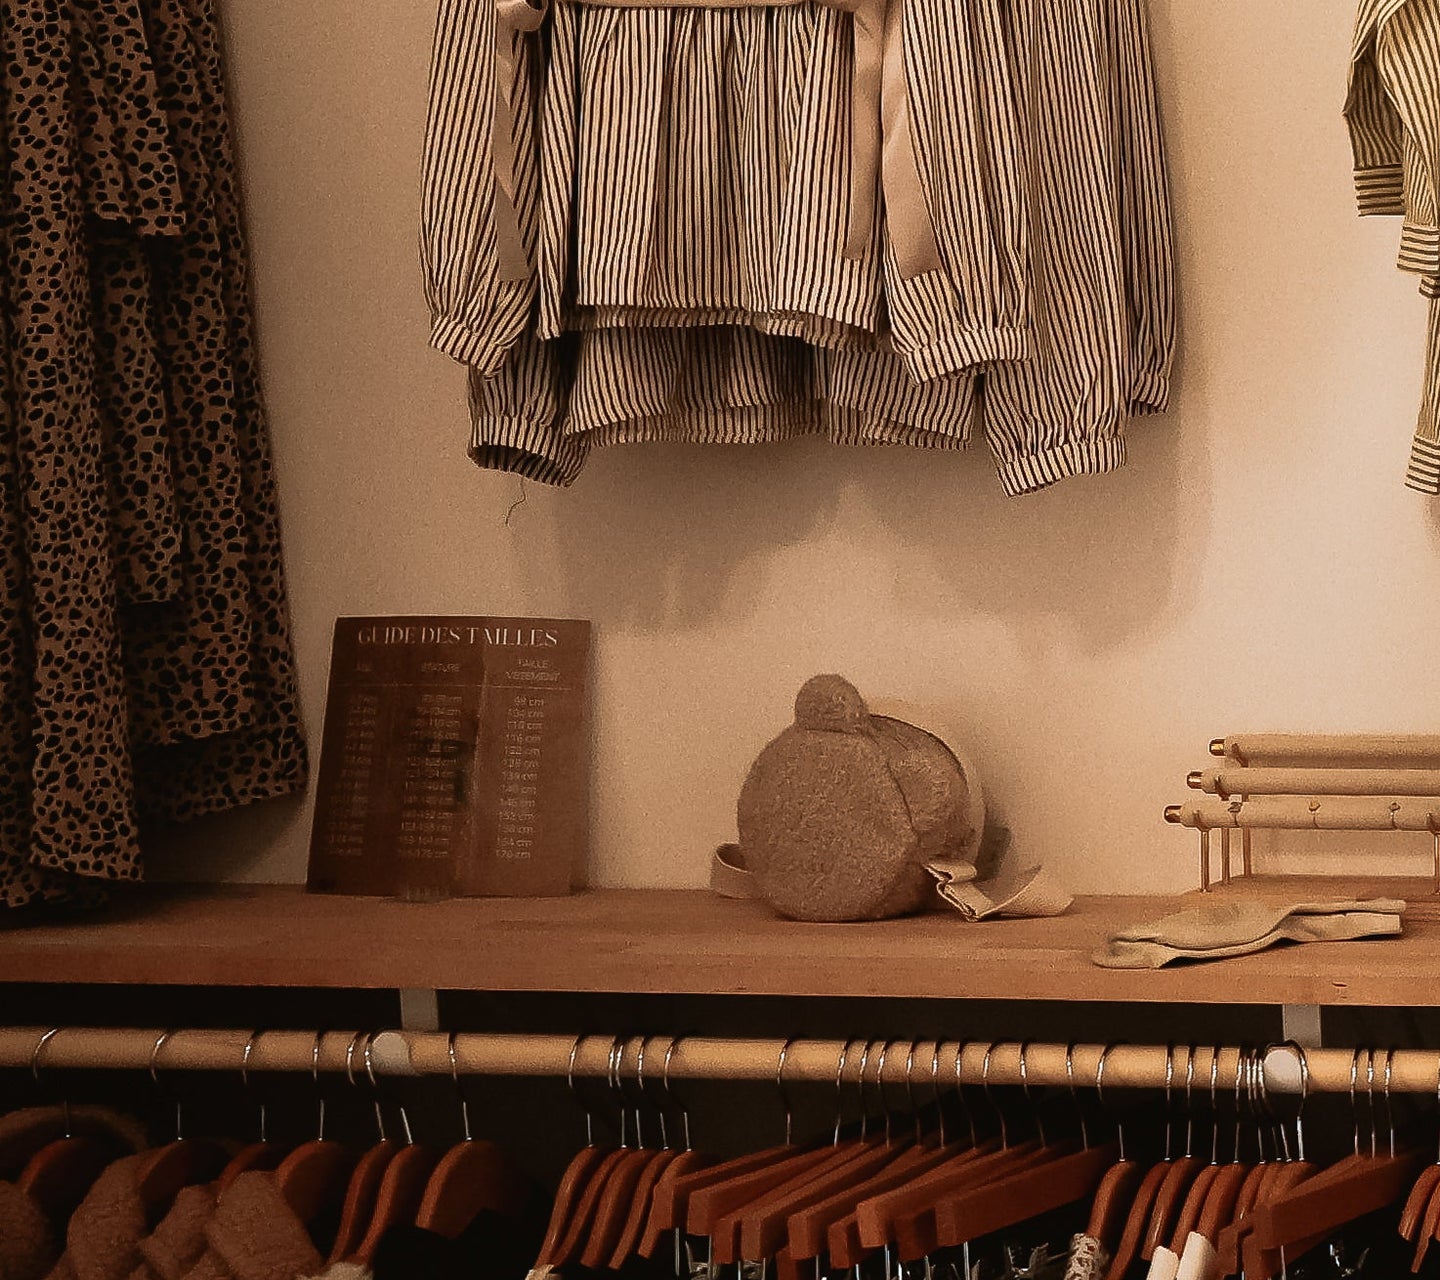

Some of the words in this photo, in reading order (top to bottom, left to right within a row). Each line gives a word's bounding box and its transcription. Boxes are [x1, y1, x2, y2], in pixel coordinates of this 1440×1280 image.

[357, 626, 416, 645] GUIDE
[421, 626, 460, 645] DES
[467, 626, 558, 646] TAILLES
